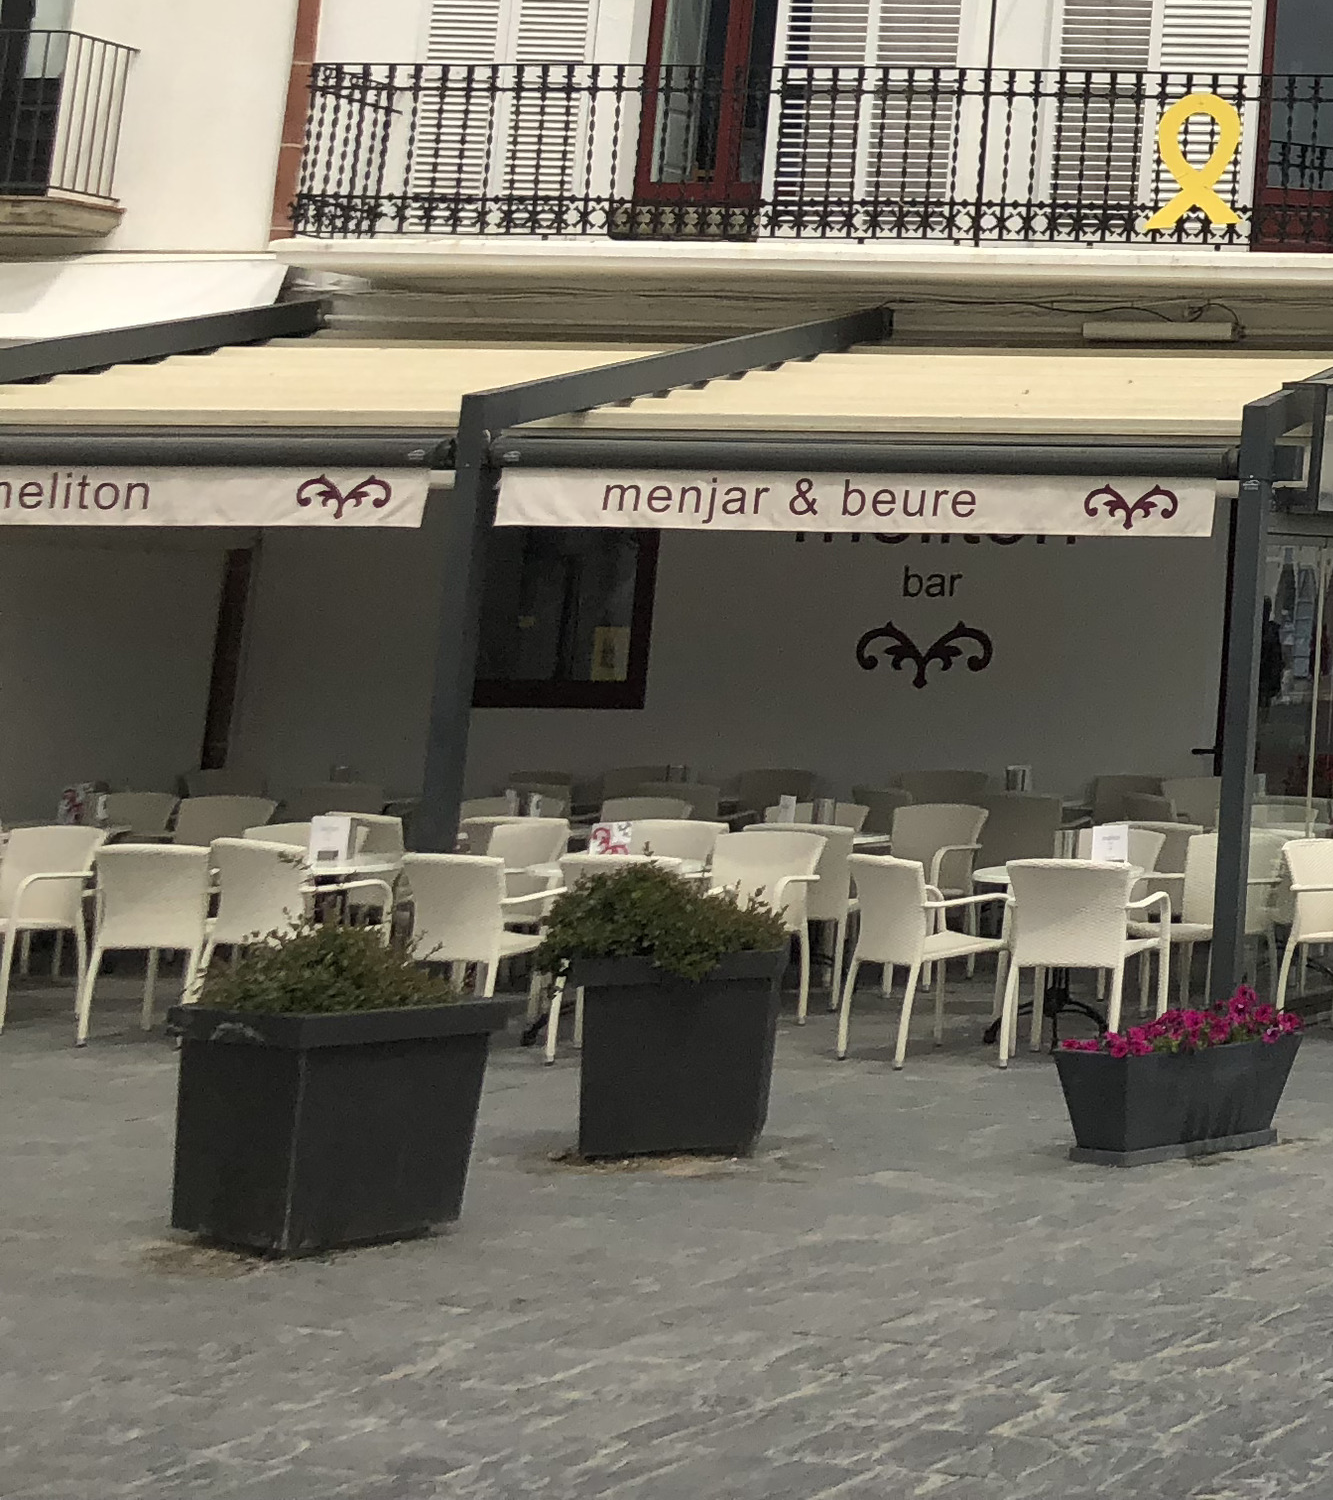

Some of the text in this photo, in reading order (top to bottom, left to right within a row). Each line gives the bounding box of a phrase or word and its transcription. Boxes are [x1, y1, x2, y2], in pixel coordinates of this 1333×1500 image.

[601, 477, 978, 525] menjar & beure
[902, 565, 963, 598] bar
